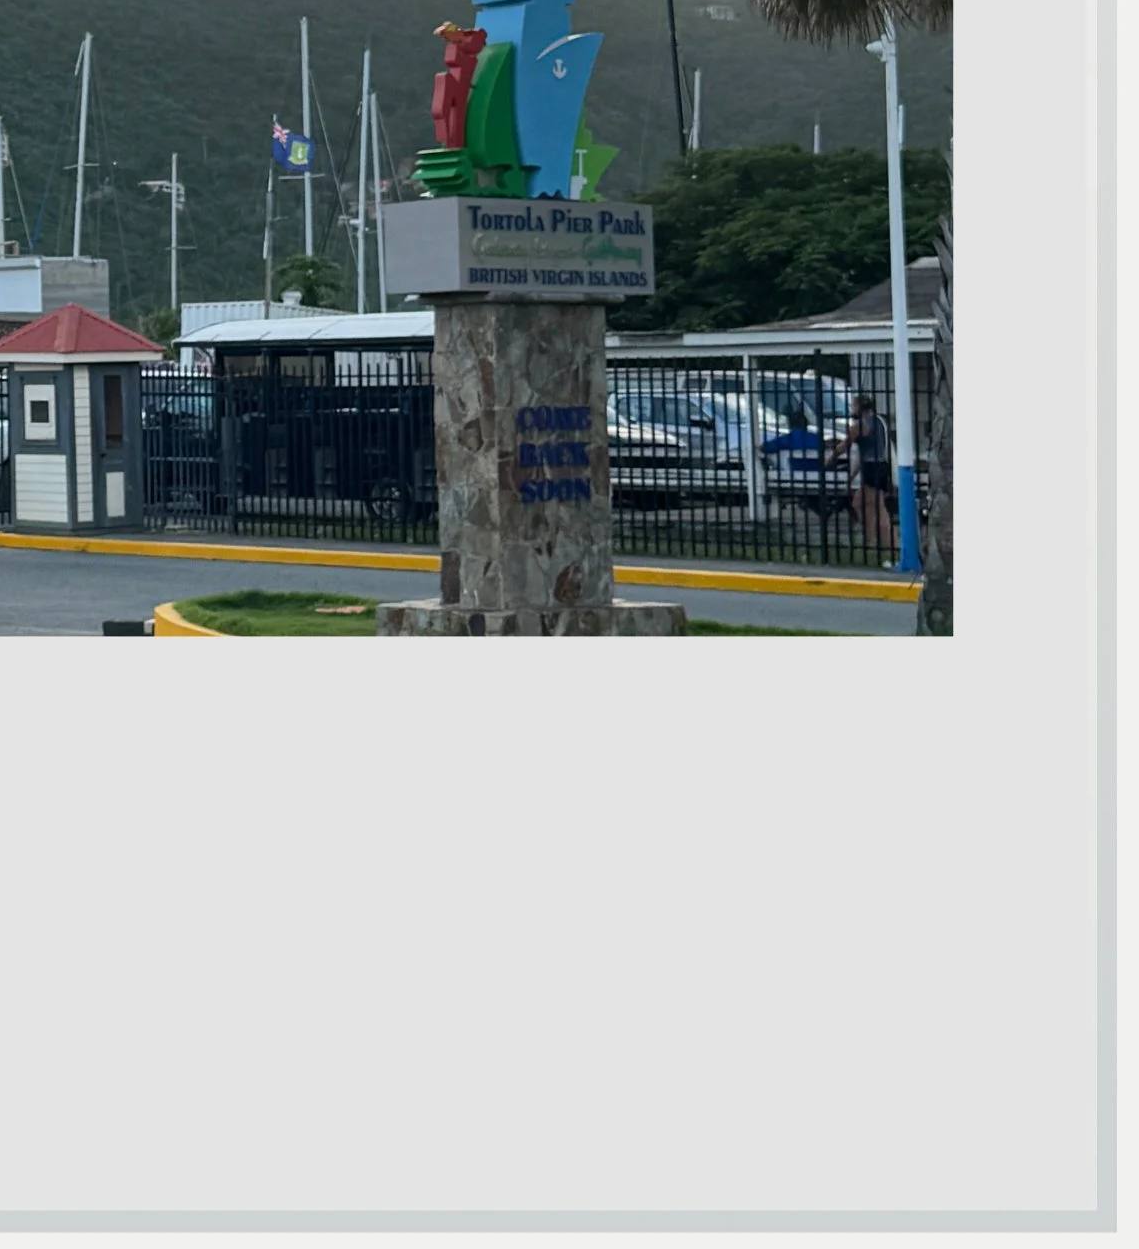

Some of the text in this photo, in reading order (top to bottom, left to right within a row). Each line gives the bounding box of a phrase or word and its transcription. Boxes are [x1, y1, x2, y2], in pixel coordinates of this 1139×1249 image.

[469, 267, 648, 286] BRITISH VIRGIN ISLANDS
[518, 406, 592, 430] COME
[519, 442, 591, 467] BACK
[520, 478, 591, 502] SOON
